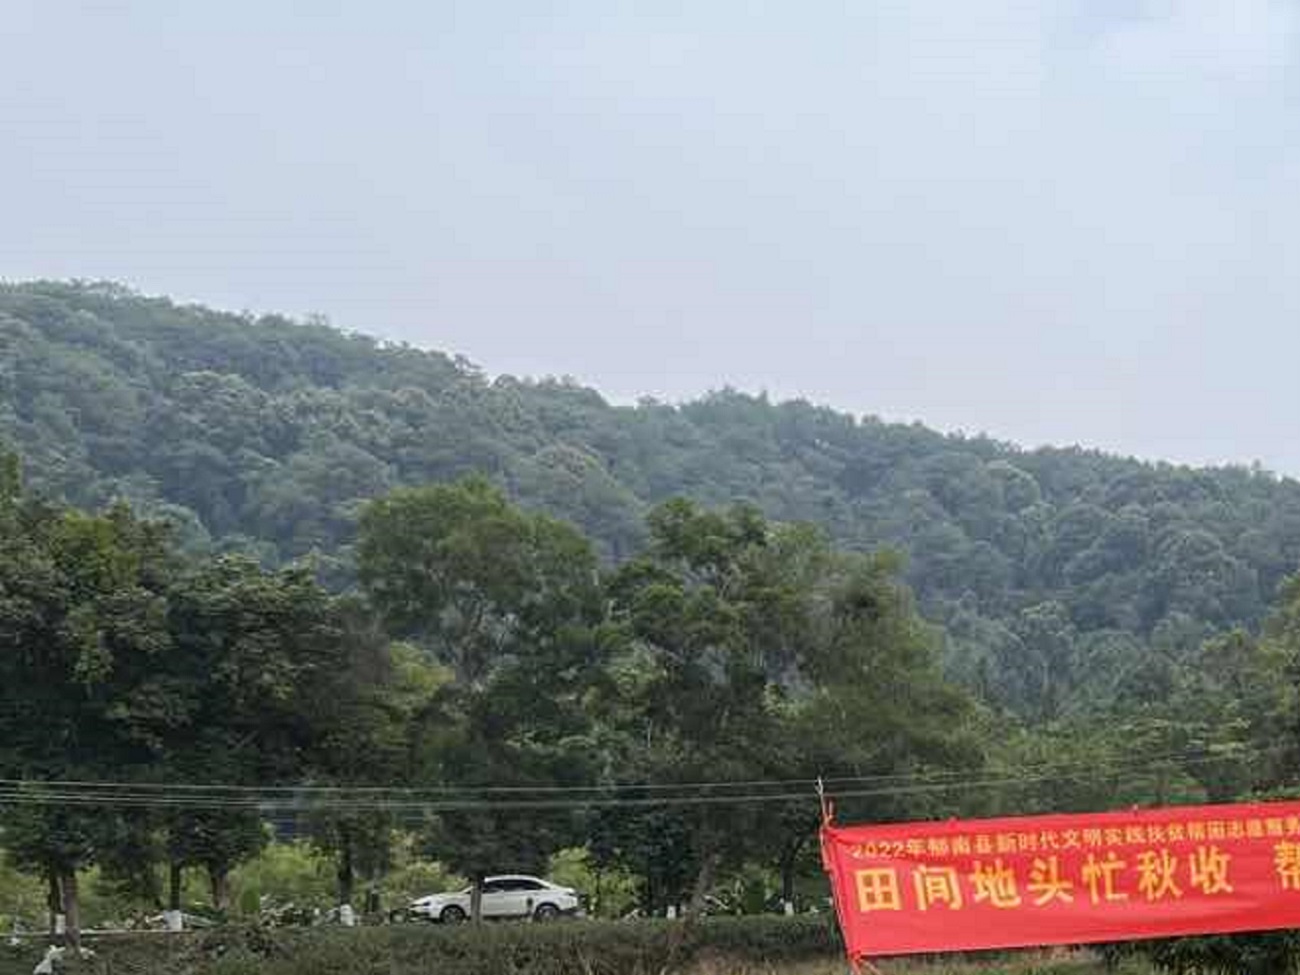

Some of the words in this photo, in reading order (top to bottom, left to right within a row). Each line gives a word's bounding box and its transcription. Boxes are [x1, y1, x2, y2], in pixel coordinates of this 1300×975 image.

[854, 845, 1234, 912] 田间地头忙秋收
